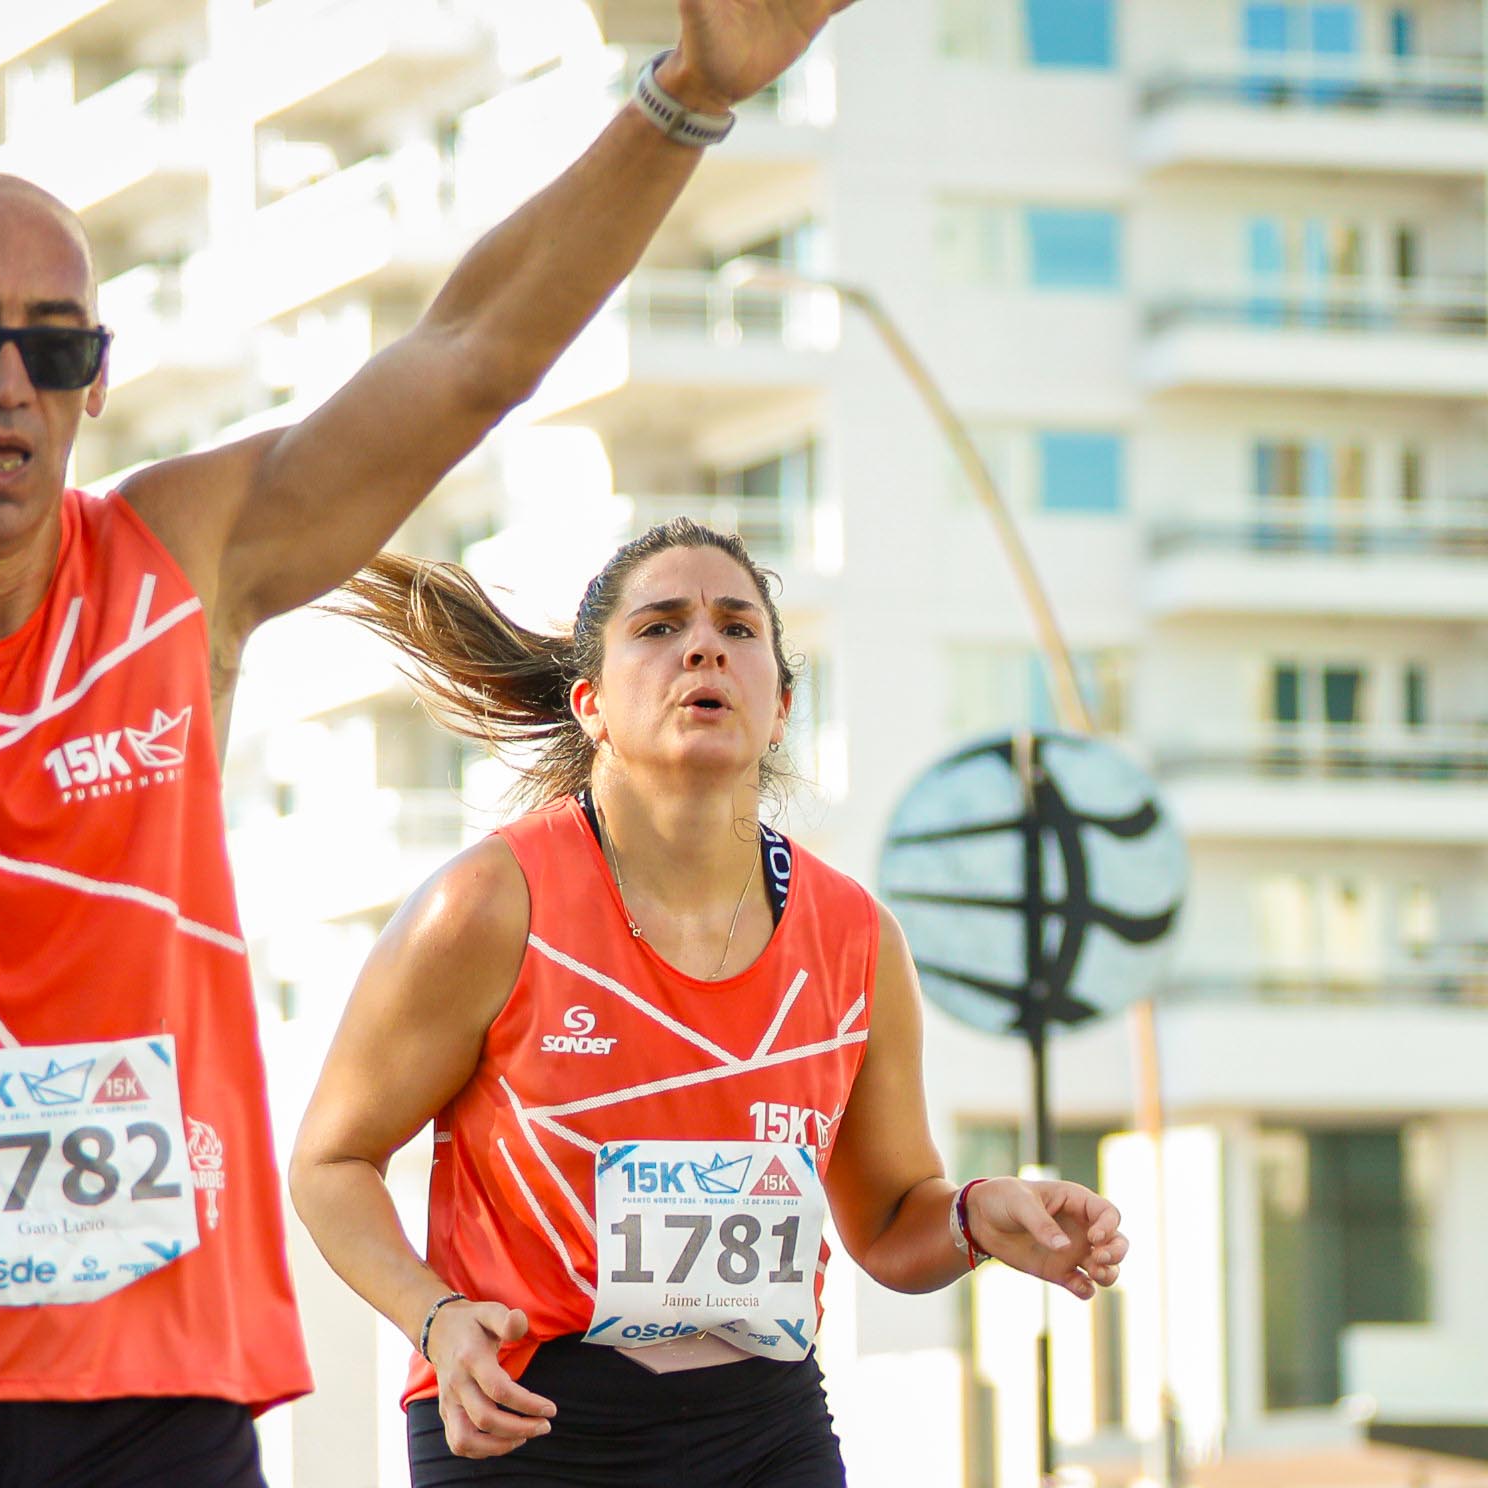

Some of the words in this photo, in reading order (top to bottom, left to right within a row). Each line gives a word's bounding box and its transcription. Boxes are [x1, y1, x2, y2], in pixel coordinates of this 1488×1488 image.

[44, 730, 132, 789] 15K
[63, 778, 133, 804] PUERTO
[104, 1078, 138, 1098] 15K
[749, 1101, 815, 1145] 15K
[621, 1162, 686, 1193] 15K
[762, 1174, 790, 1191] 15K
[610, 1214, 804, 1285] 1781
[662, 1293, 701, 1308] Jaime
[706, 1293, 760, 1308] Lucrecia
[621, 1321, 699, 1341] osde
